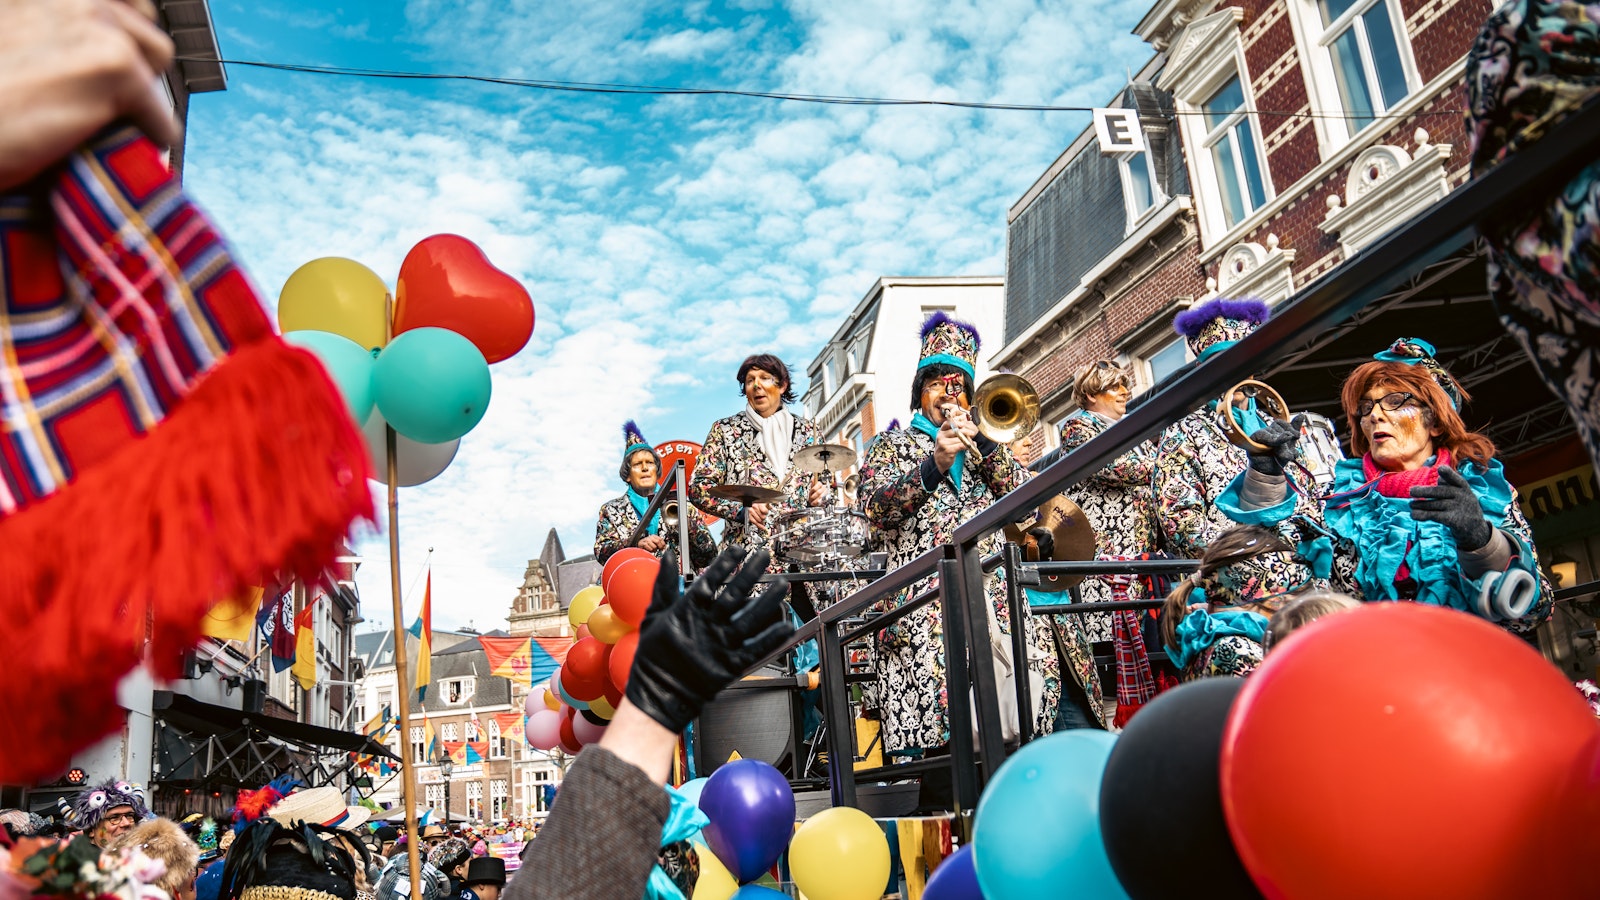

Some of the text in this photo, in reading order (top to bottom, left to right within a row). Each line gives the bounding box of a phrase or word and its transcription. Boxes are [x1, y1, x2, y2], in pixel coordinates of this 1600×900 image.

[1105, 115, 1133, 145] E
[656, 444, 693, 459] ts en
